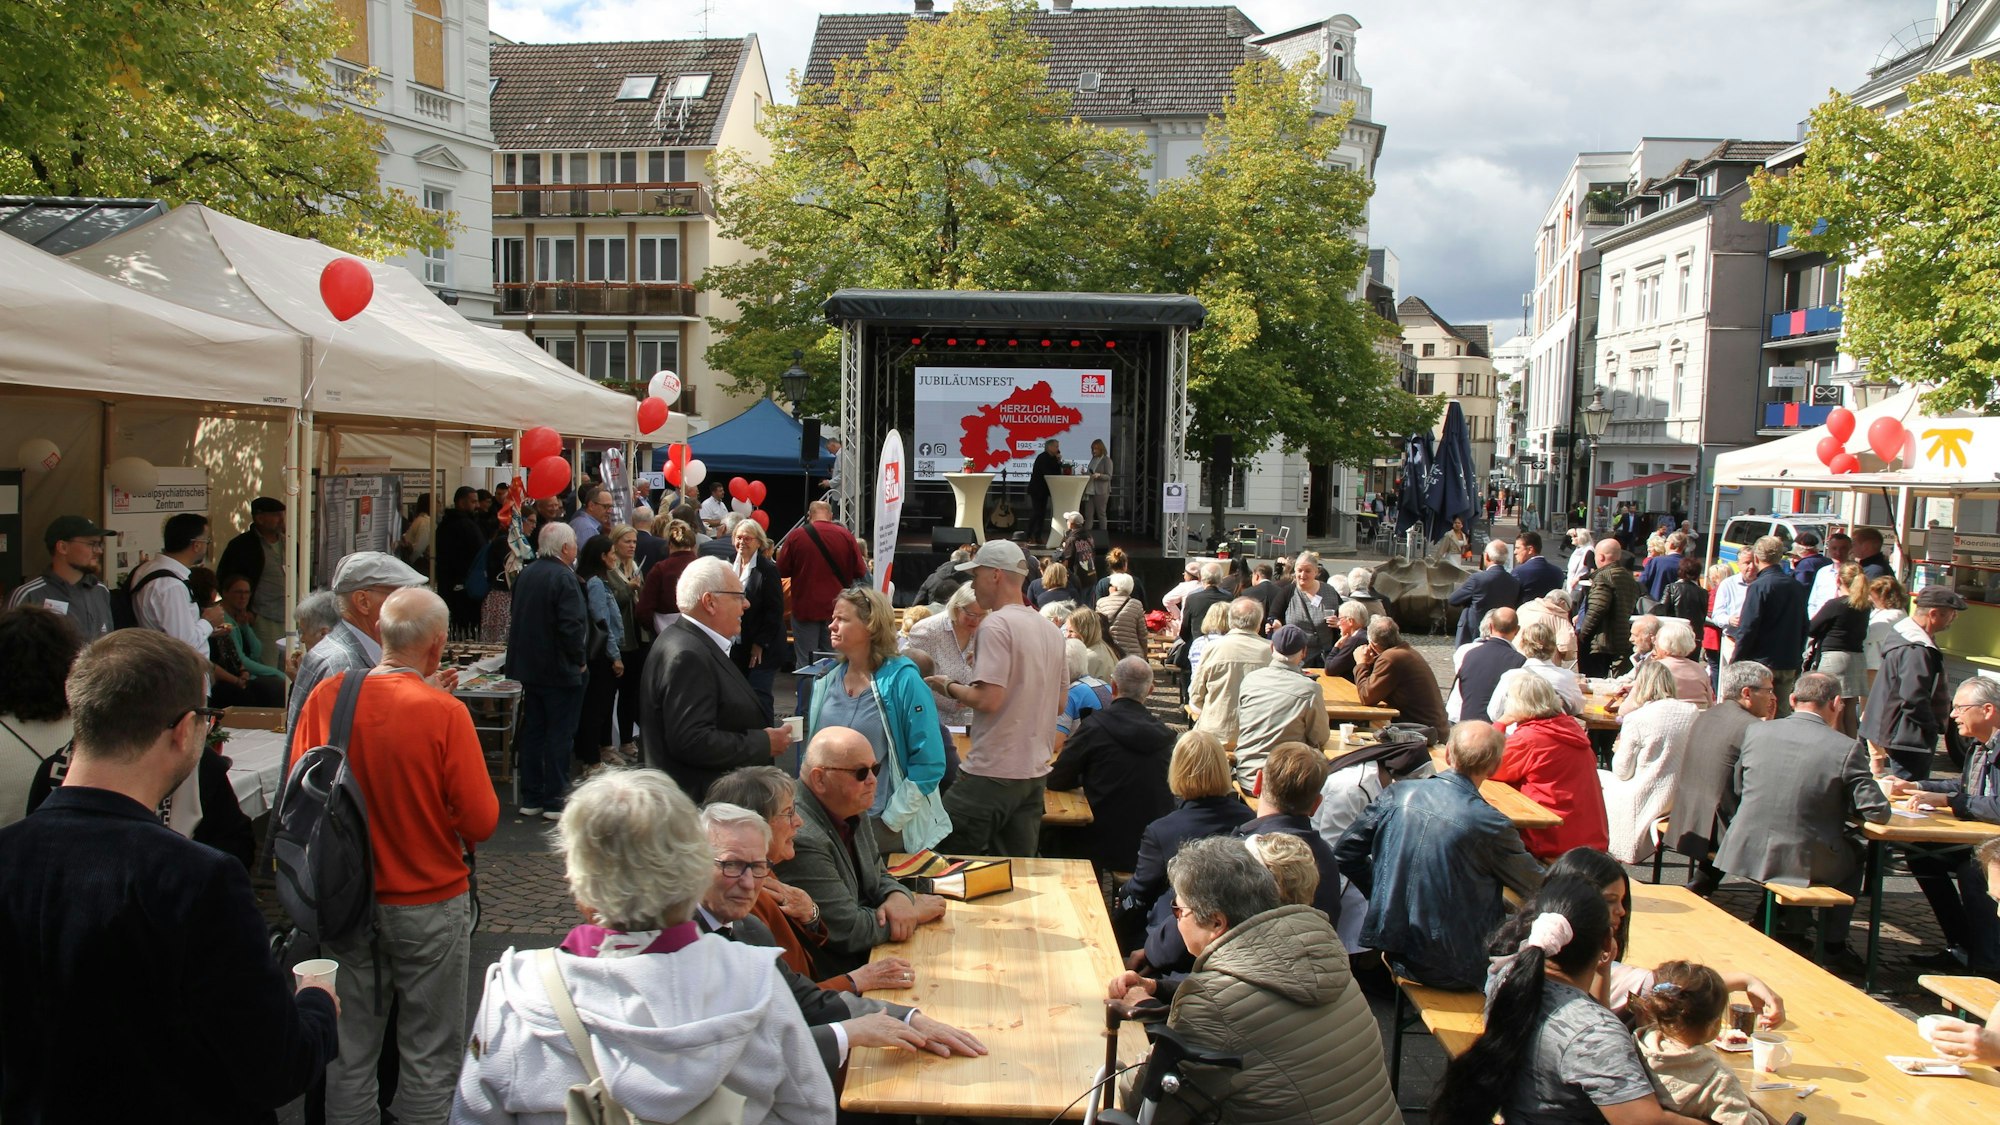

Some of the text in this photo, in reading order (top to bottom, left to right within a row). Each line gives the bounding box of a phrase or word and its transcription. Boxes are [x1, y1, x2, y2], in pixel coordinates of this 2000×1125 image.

[918, 374, 1014, 386] JUBILÄUMSFEST
[1082, 384, 1104, 393] SKM
[1000, 404, 1050, 413] HERZLICH
[1000, 415, 1069, 424] WILLKOMMEN
[886, 483, 899, 500] SKM
[156, 500, 184, 510] Zentrum
